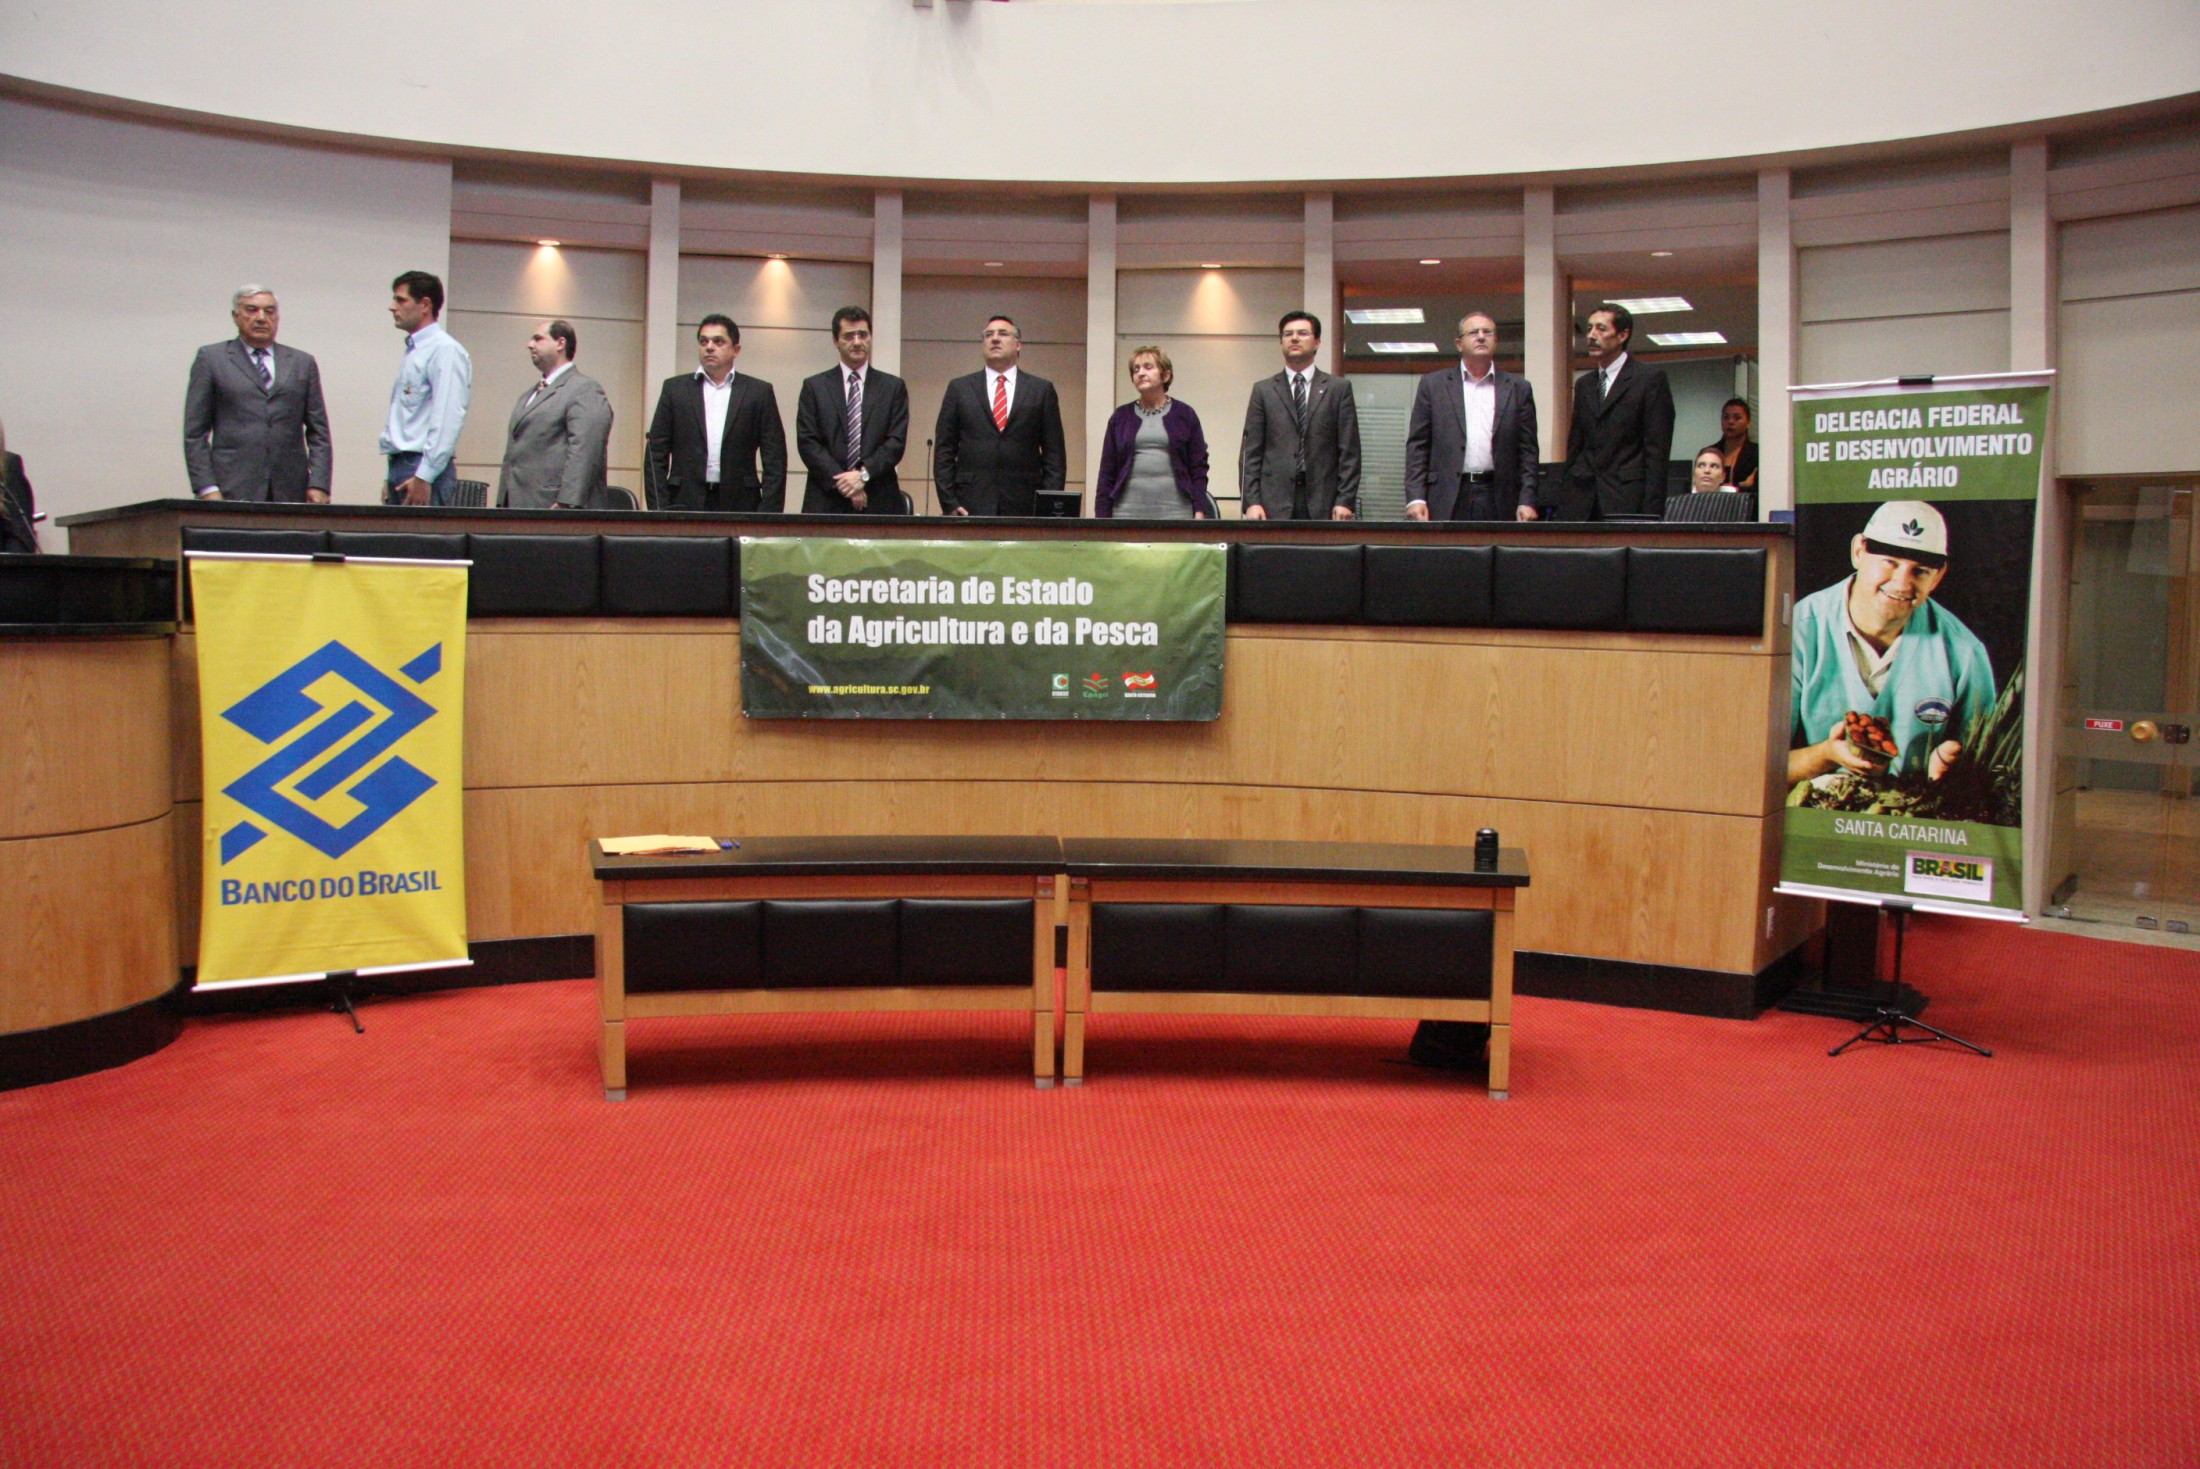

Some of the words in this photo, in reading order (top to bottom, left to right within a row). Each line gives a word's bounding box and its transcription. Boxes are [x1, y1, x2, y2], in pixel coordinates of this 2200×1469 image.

[1815, 409, 1921, 433] DELEGACIA
[1928, 404, 2023, 428] FEDERAL
[1806, 442, 1829, 462] DE
[1836, 433, 2032, 461] DESENVOLVIMENTO
[1868, 462, 1958, 489] AGRÁRIO
[808, 574, 955, 605] Secretaria
[961, 576, 995, 605] de
[1002, 577, 1094, 606] Estado
[808, 615, 844, 644] da
[848, 616, 1003, 647] Agricultura
[1011, 622, 1029, 645] e
[1035, 618, 1069, 645] da
[1076, 619, 1158, 646] Pesca
[808, 684, 930, 696] www.agricultura.sc.gov.br
[1834, 818, 1884, 837] SANTA
[1889, 823, 1968, 845] CATARINA
[1912, 857, 1983, 881] BRASIL
[221, 878, 315, 905] BANCO
[320, 876, 354, 899] DO
[358, 870, 442, 896] BRASIL
